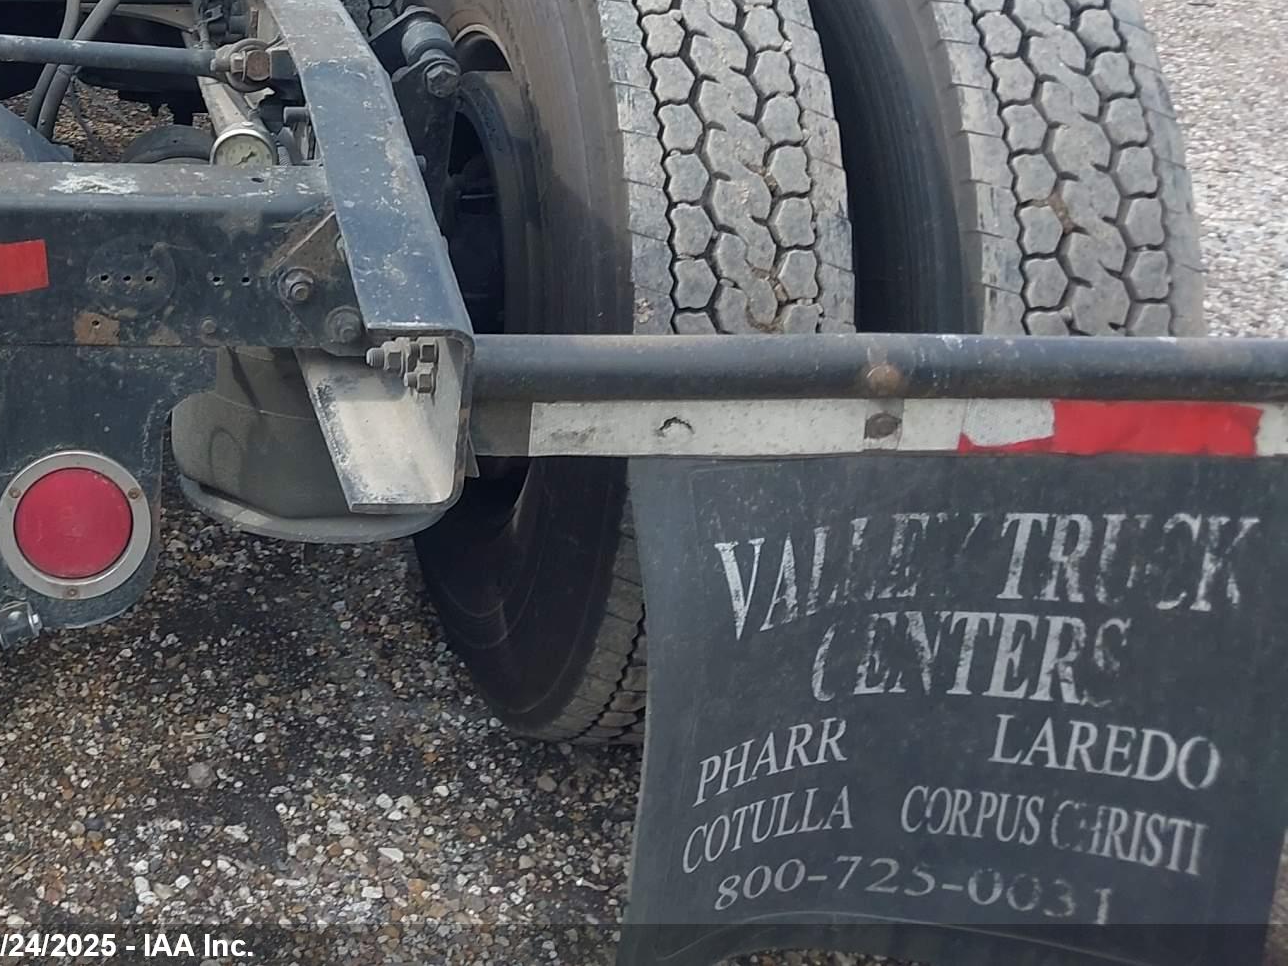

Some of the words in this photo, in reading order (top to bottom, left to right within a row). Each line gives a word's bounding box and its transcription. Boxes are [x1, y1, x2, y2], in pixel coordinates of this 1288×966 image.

[996, 512, 1260, 612] TRUCK
[811, 610, 1132, 707] CENTERS
[693, 717, 848, 807] PHARR
[988, 714, 1220, 790] LAREDO
[682, 786, 854, 874] COTULLA
[901, 785, 1045, 846] CORPUS
[1051, 800, 1210, 876] CHRISTI
